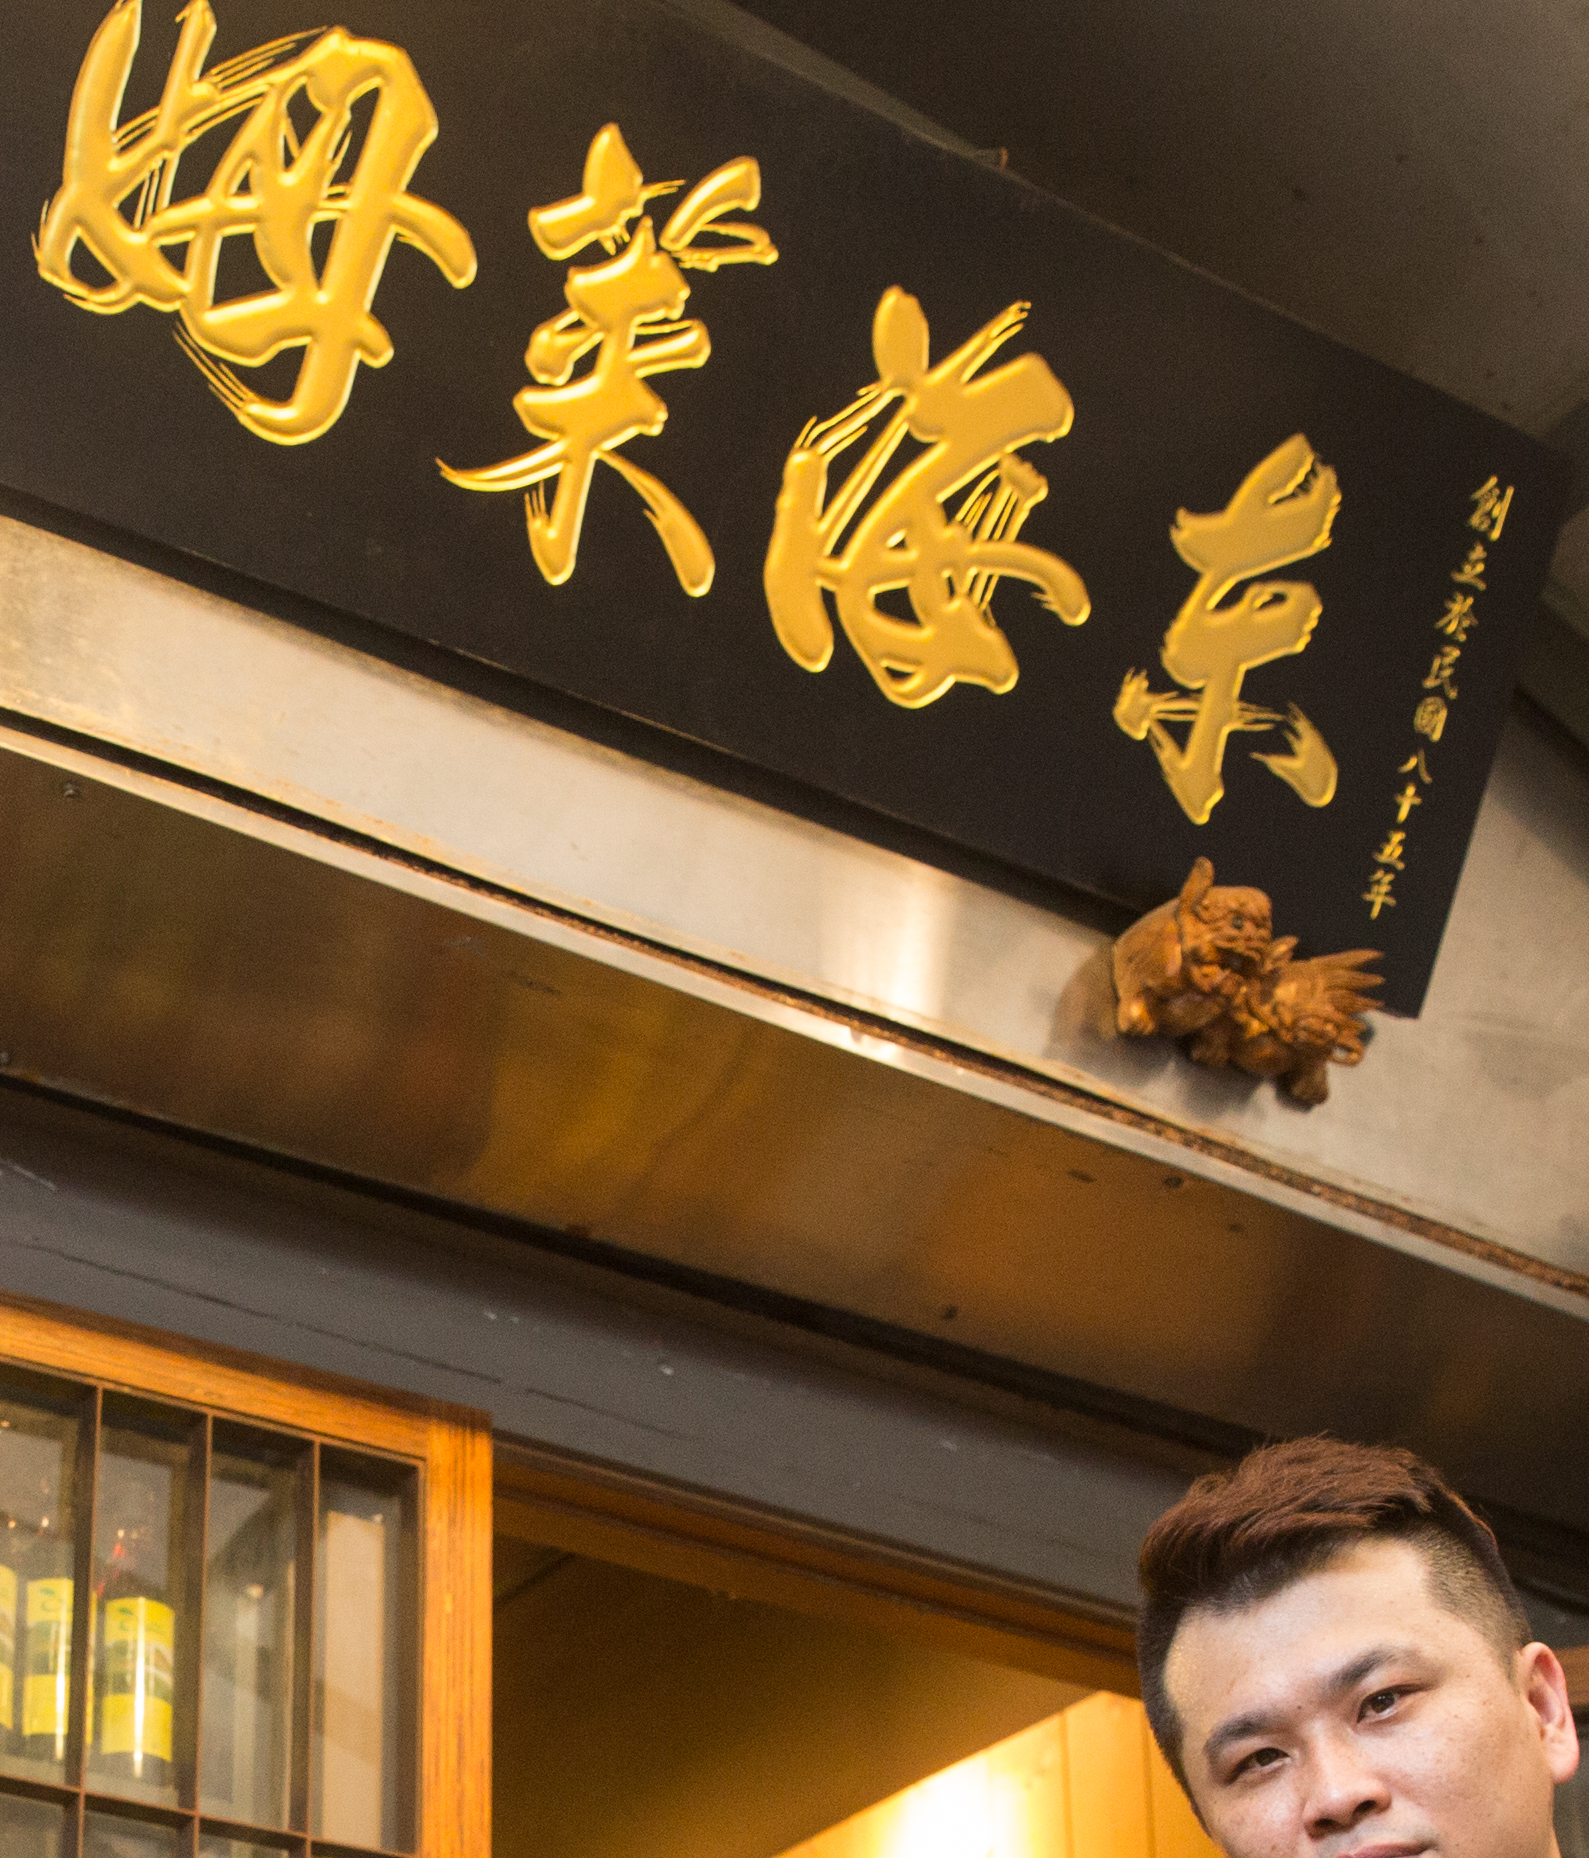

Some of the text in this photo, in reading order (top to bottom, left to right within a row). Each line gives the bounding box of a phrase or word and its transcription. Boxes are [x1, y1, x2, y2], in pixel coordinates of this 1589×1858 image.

[1362, 473, 1516, 921] 創立於民國八十五年
